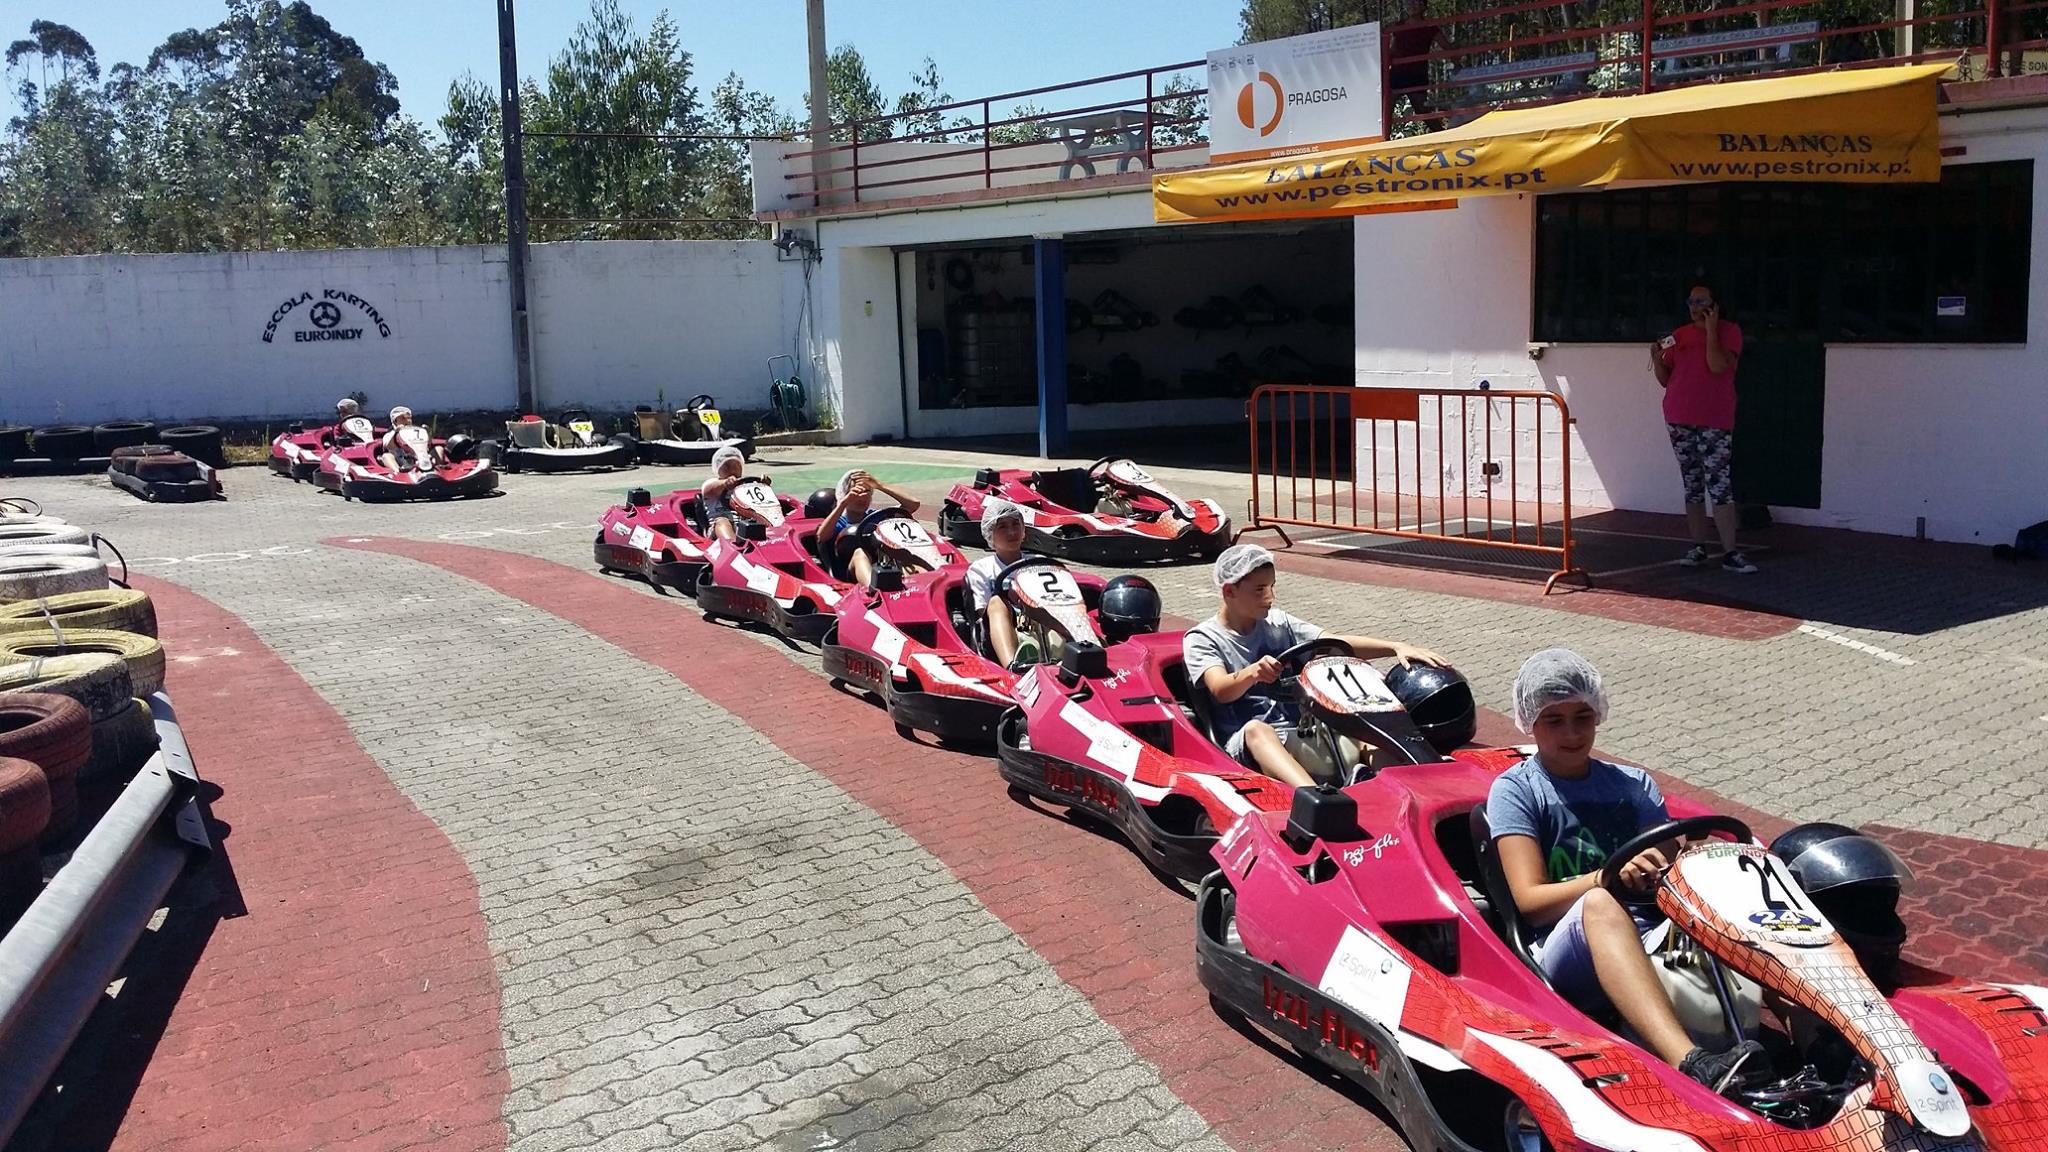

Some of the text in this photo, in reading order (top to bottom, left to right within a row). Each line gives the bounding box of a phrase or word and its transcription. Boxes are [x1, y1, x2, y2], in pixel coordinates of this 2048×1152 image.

[1288, 86, 1348, 107] PRAGOSA
[1718, 133, 1873, 157] BALANÇAS
[1264, 147, 1476, 184] BALANÇAS
[1215, 167, 1546, 208] www.pestronix.pt
[262, 289, 391, 343] ESCOLA KARTING
[295, 328, 363, 342] EUROINDY
[746, 486, 765, 502] 16
[894, 522, 917, 541] 12
[1037, 571, 1063, 593] 2
[1327, 664, 1370, 700] 11
[1738, 855, 1804, 911] 21
